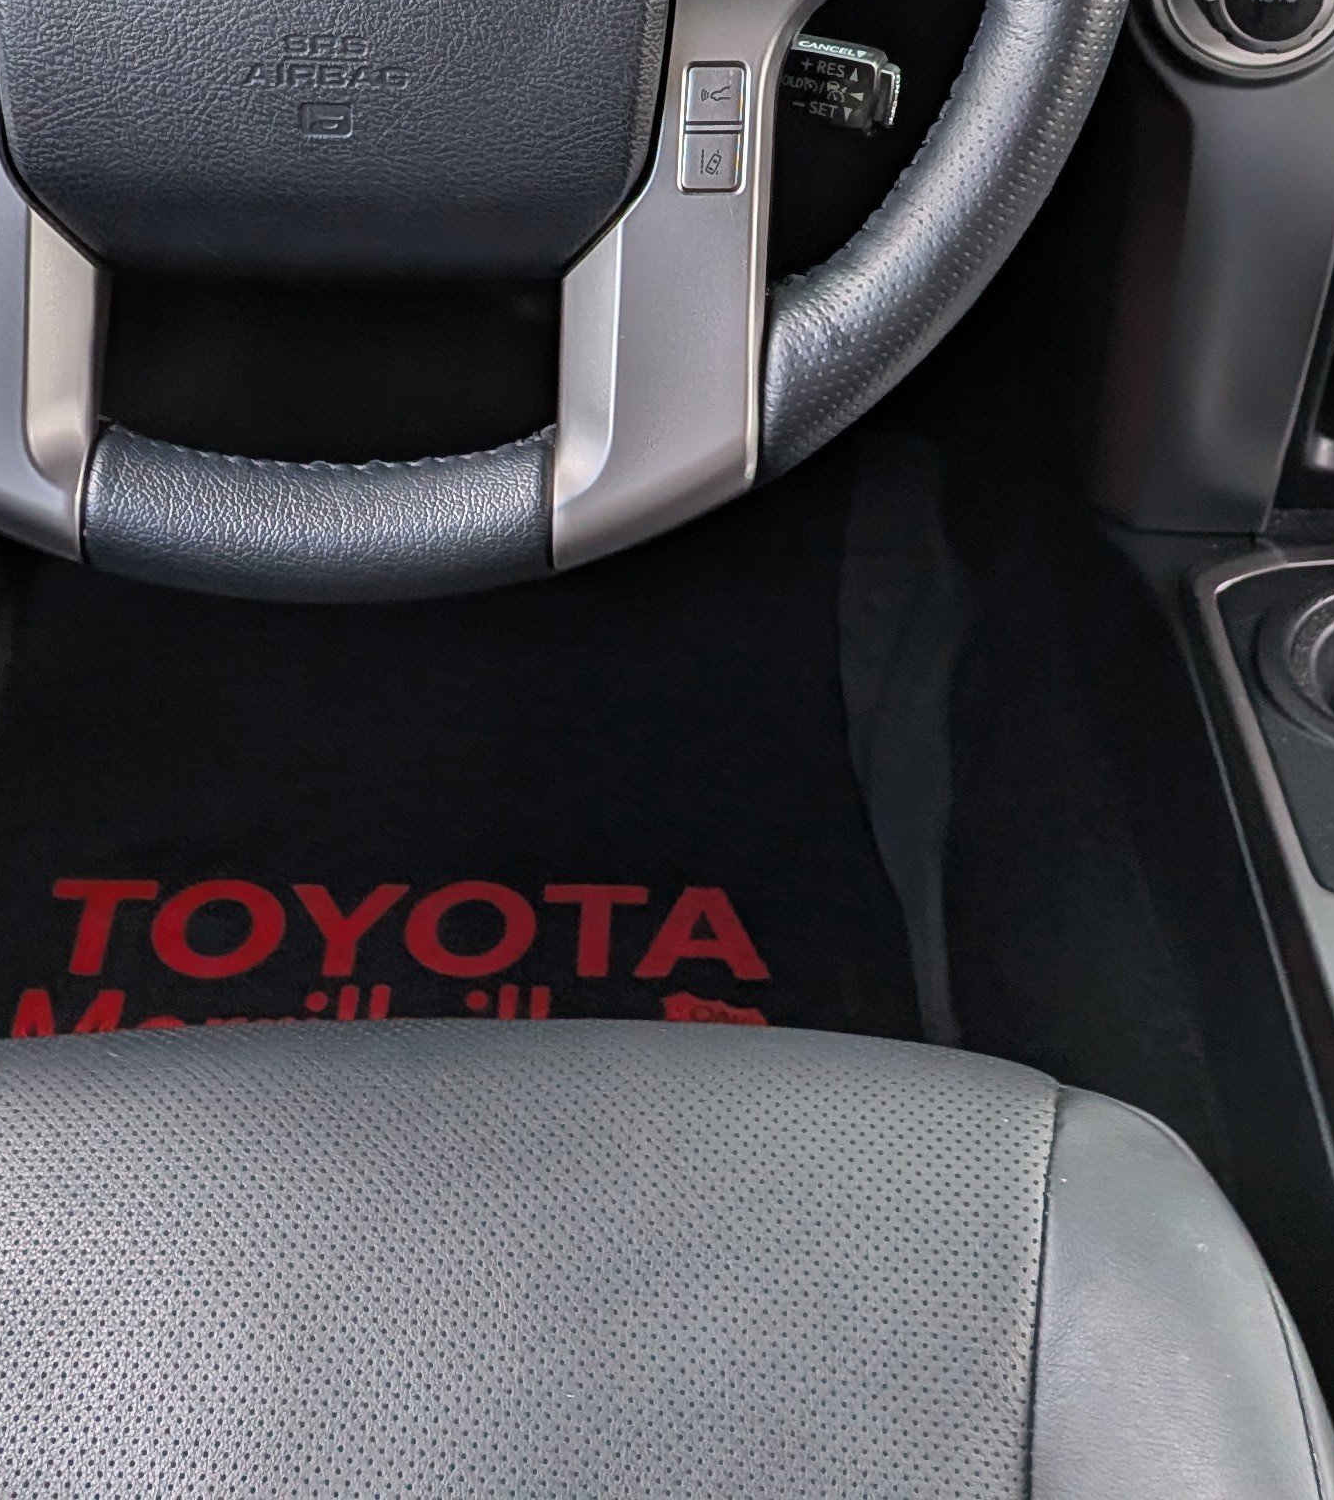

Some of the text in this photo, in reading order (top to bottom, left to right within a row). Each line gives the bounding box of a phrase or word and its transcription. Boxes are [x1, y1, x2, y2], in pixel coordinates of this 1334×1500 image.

[284, 34, 368, 56] SRS
[798, 40, 856, 57] CANCEL
[242, 63, 410, 90] AIRBAG
[809, 100, 839, 119] SET
[53, 878, 771, 981] TOYOTA
